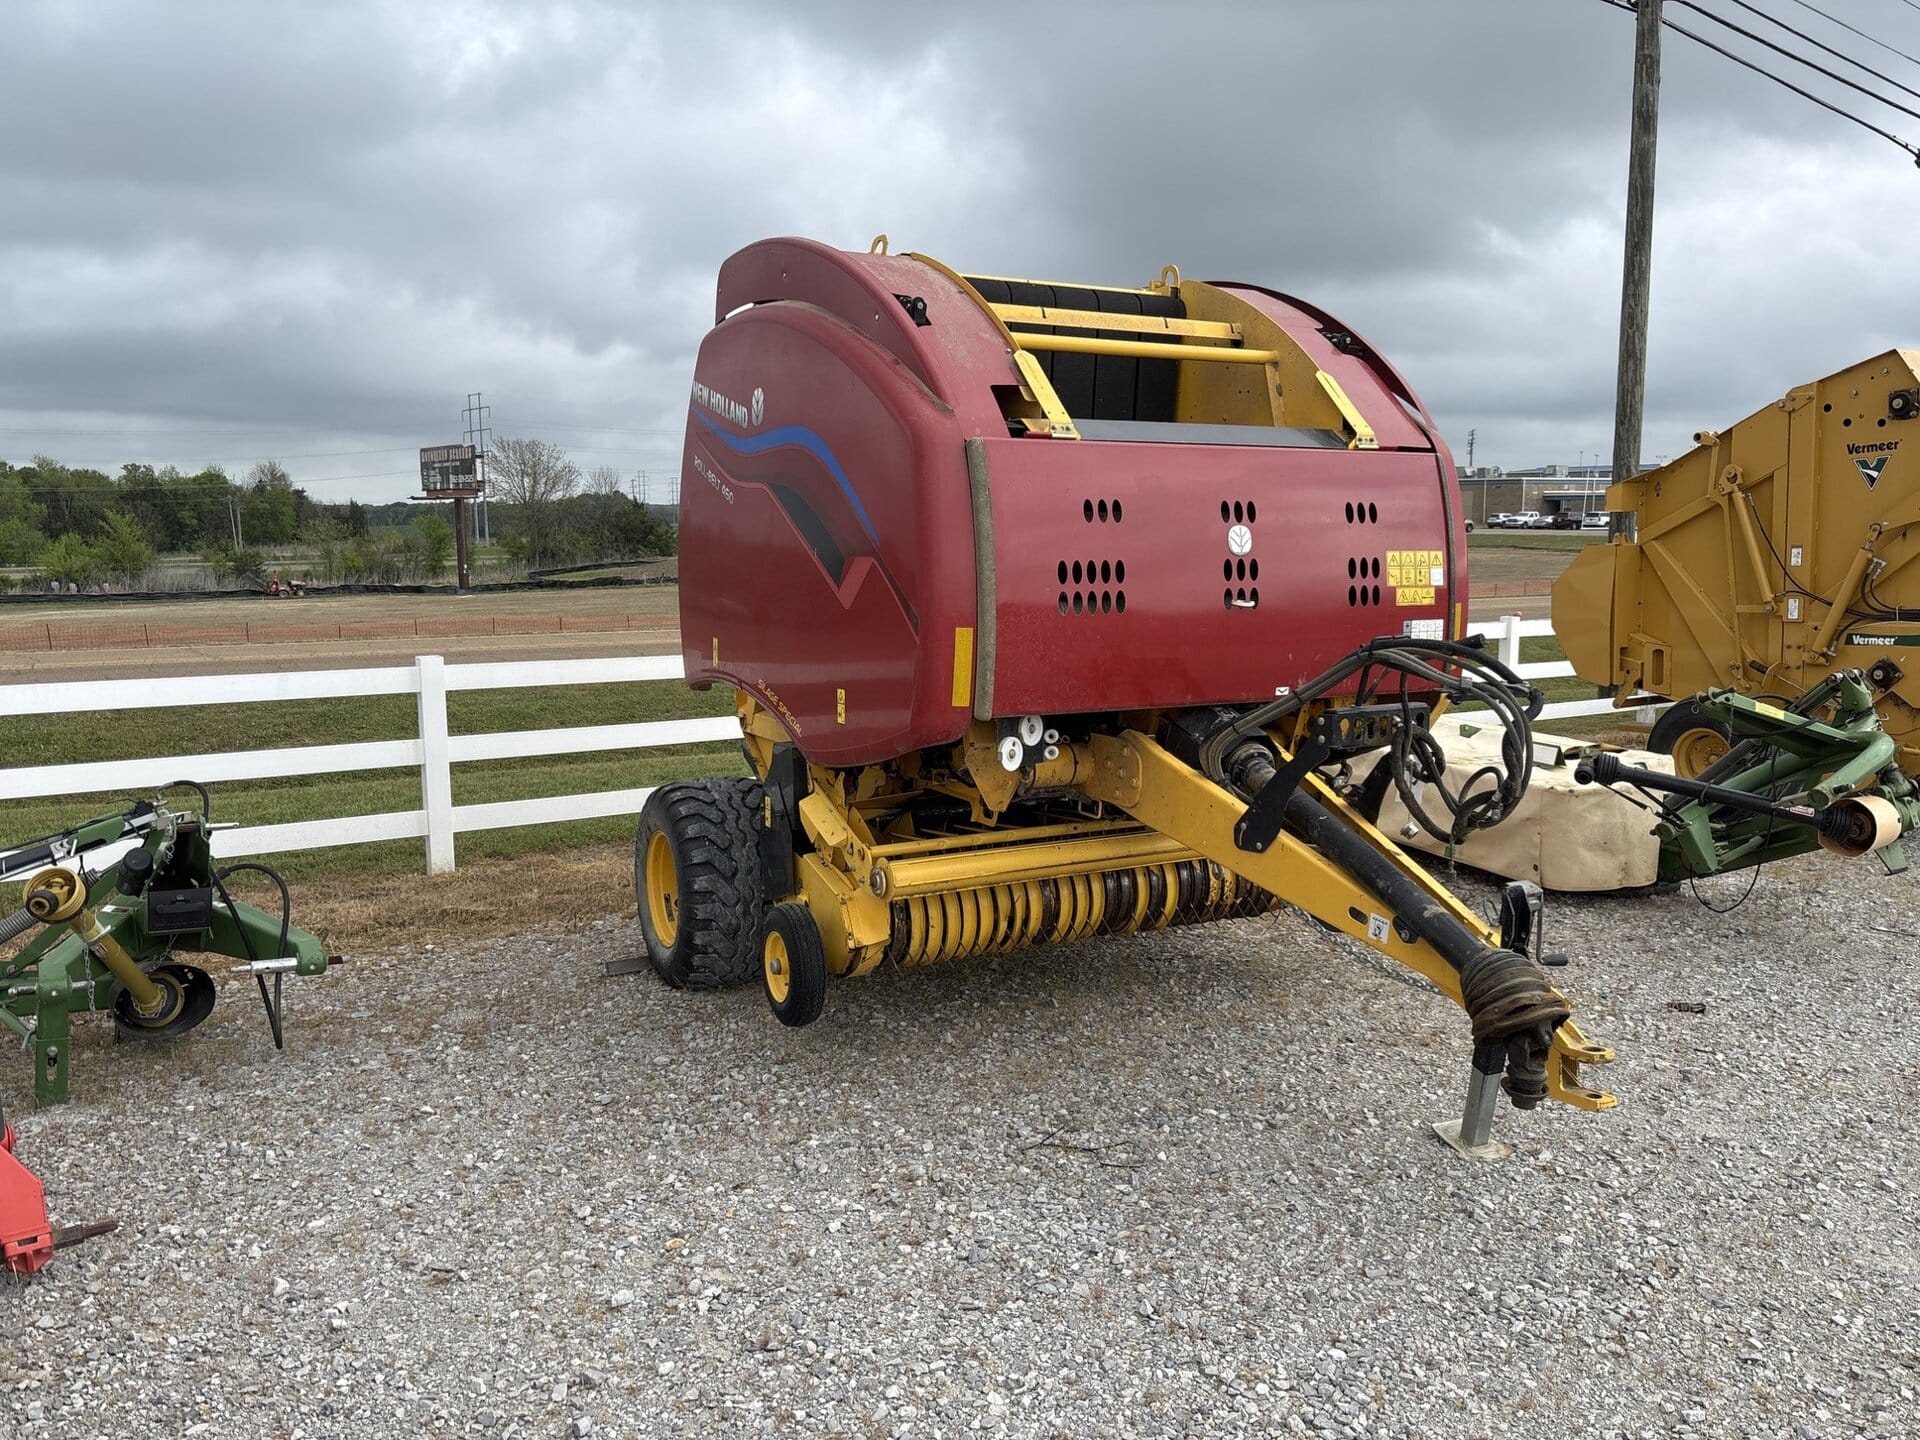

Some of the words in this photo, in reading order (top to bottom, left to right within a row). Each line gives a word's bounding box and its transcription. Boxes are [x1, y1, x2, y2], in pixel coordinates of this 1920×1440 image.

[692, 381, 709, 407] NEW
[710, 389, 748, 429] HOLLAND
[1847, 440, 1900, 455] Vermeer
[1852, 635, 1897, 645] Vermeer
[757, 679, 779, 705] SILAGE
[778, 702, 802, 737] SPECIAL
